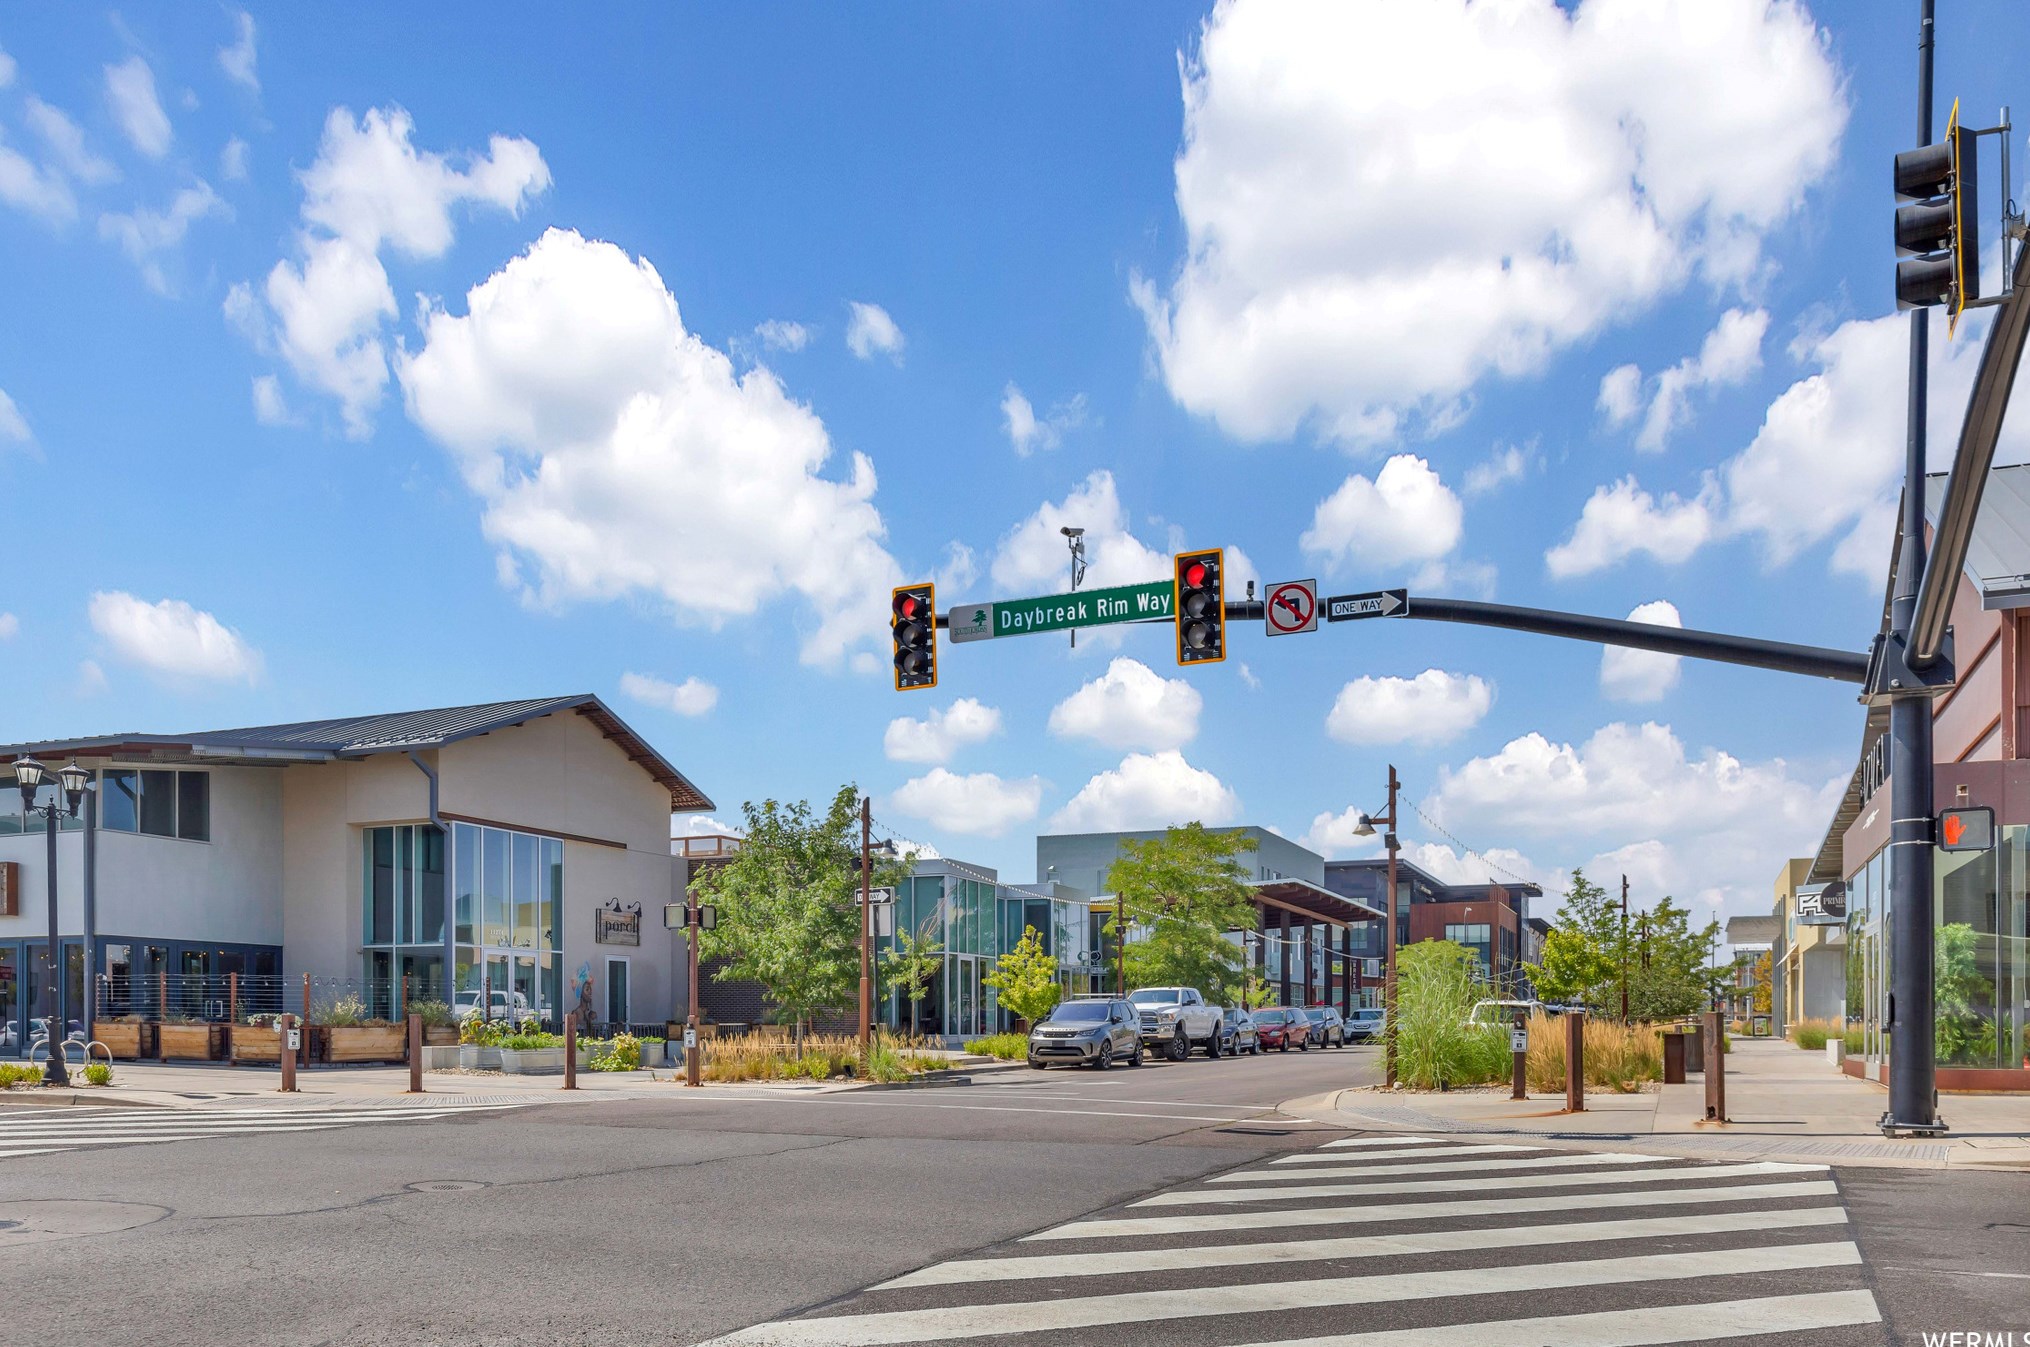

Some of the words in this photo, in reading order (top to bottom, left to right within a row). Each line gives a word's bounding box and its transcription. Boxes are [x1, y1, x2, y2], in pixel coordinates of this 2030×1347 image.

[1001, 601, 1087, 631] Daybreak
[1097, 597, 1129, 618] Rim
[1136, 592, 1171, 614] Way
[1334, 602, 1356, 614] ONE
[1360, 599, 1382, 611] WAY
